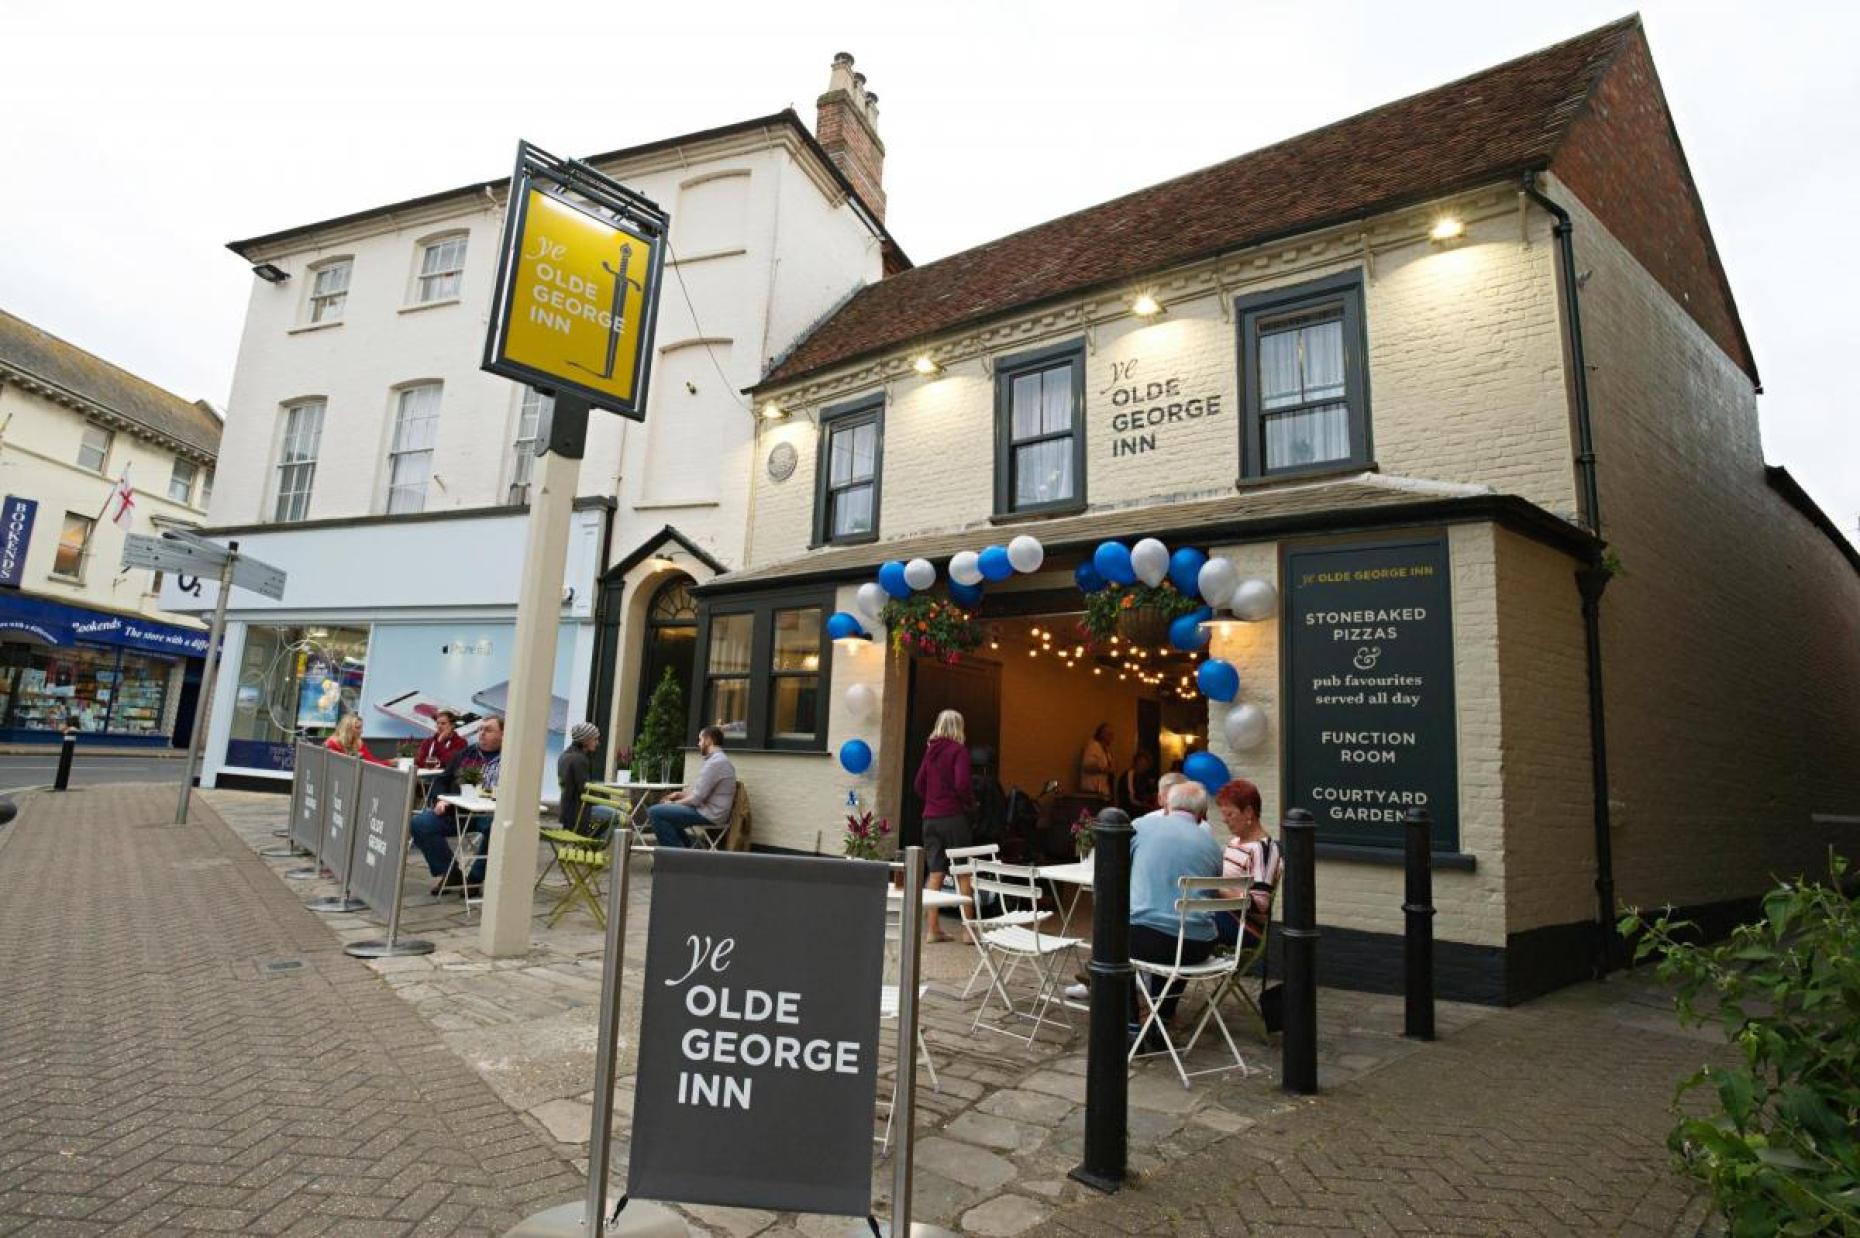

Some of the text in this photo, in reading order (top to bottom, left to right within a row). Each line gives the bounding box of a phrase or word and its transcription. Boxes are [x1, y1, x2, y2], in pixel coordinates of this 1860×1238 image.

[526, 236, 567, 260] ye
[536, 262, 598, 300] OLDE
[529, 305, 571, 335] INN
[533, 284, 625, 334] GEORGE
[1112, 378, 1181, 406] OLDE
[1112, 395, 1221, 432] GEORGE
[1112, 433, 1156, 457] INN
[0, 503, 26, 579] BOOKENDS
[1318, 571, 1351, 582] OLDE
[1354, 567, 1408, 580] GEORGE
[1410, 564, 1433, 577] INN
[1306, 608, 1427, 625] STONEBAKED
[1333, 627, 1397, 641] PIZZAS
[1353, 647, 1381, 670] &
[1313, 674, 1422, 690] pub favourites
[1316, 692, 1421, 707] served all day
[1321, 731, 1416, 745] FUNCTION
[1341, 750, 1396, 763] ROOM
[1312, 787, 1427, 805] COURTYARD
[1329, 806, 1407, 822] GARDEN
[664, 934, 735, 986] ye
[685, 984, 802, 1024] OLDE
[681, 1028, 861, 1074] GEORGE
[678, 1071, 752, 1110] INN
